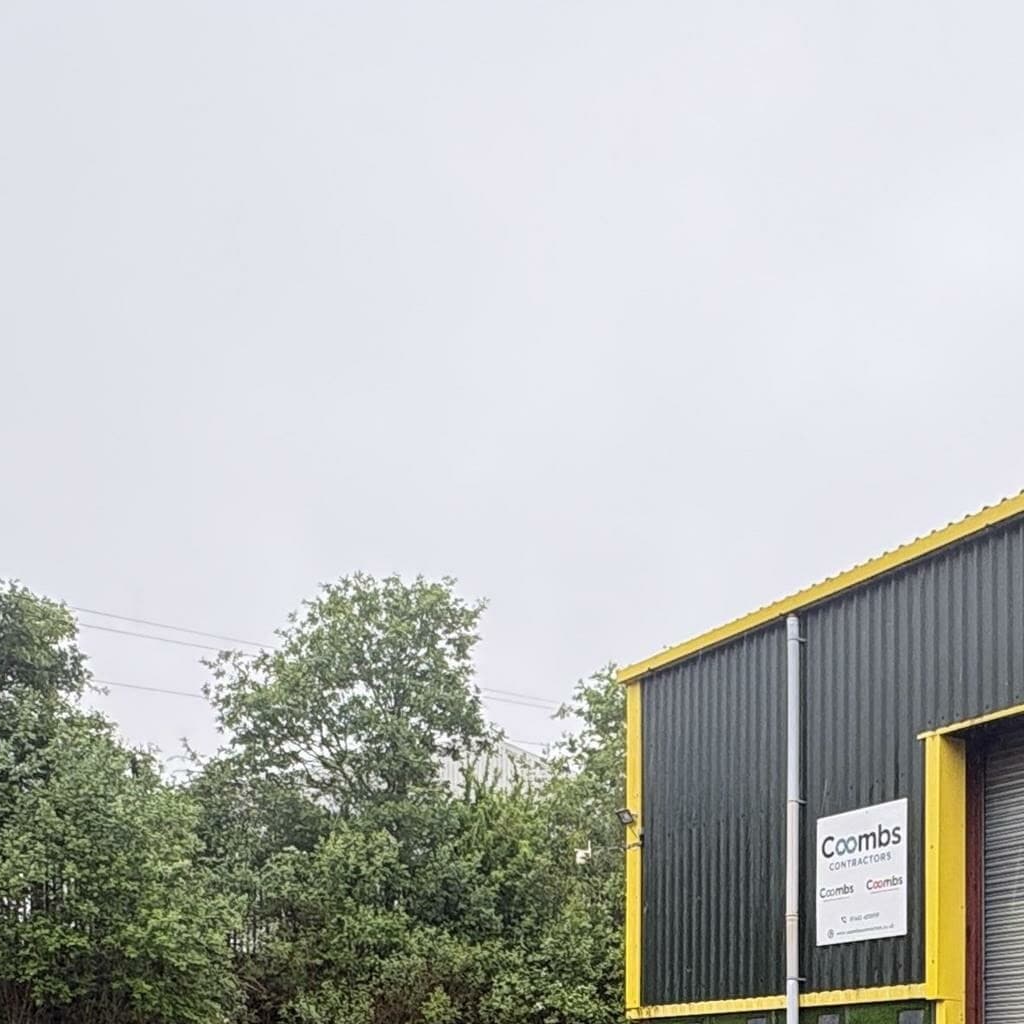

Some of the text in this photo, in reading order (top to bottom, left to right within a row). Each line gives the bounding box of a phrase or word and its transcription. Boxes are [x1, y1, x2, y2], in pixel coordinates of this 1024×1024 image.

[821, 824, 901, 858] Coombs
[829, 851, 892, 872] CONTRACTORS
[819, 883, 854, 899] Coombs
[866, 875, 903, 891] Coombs
